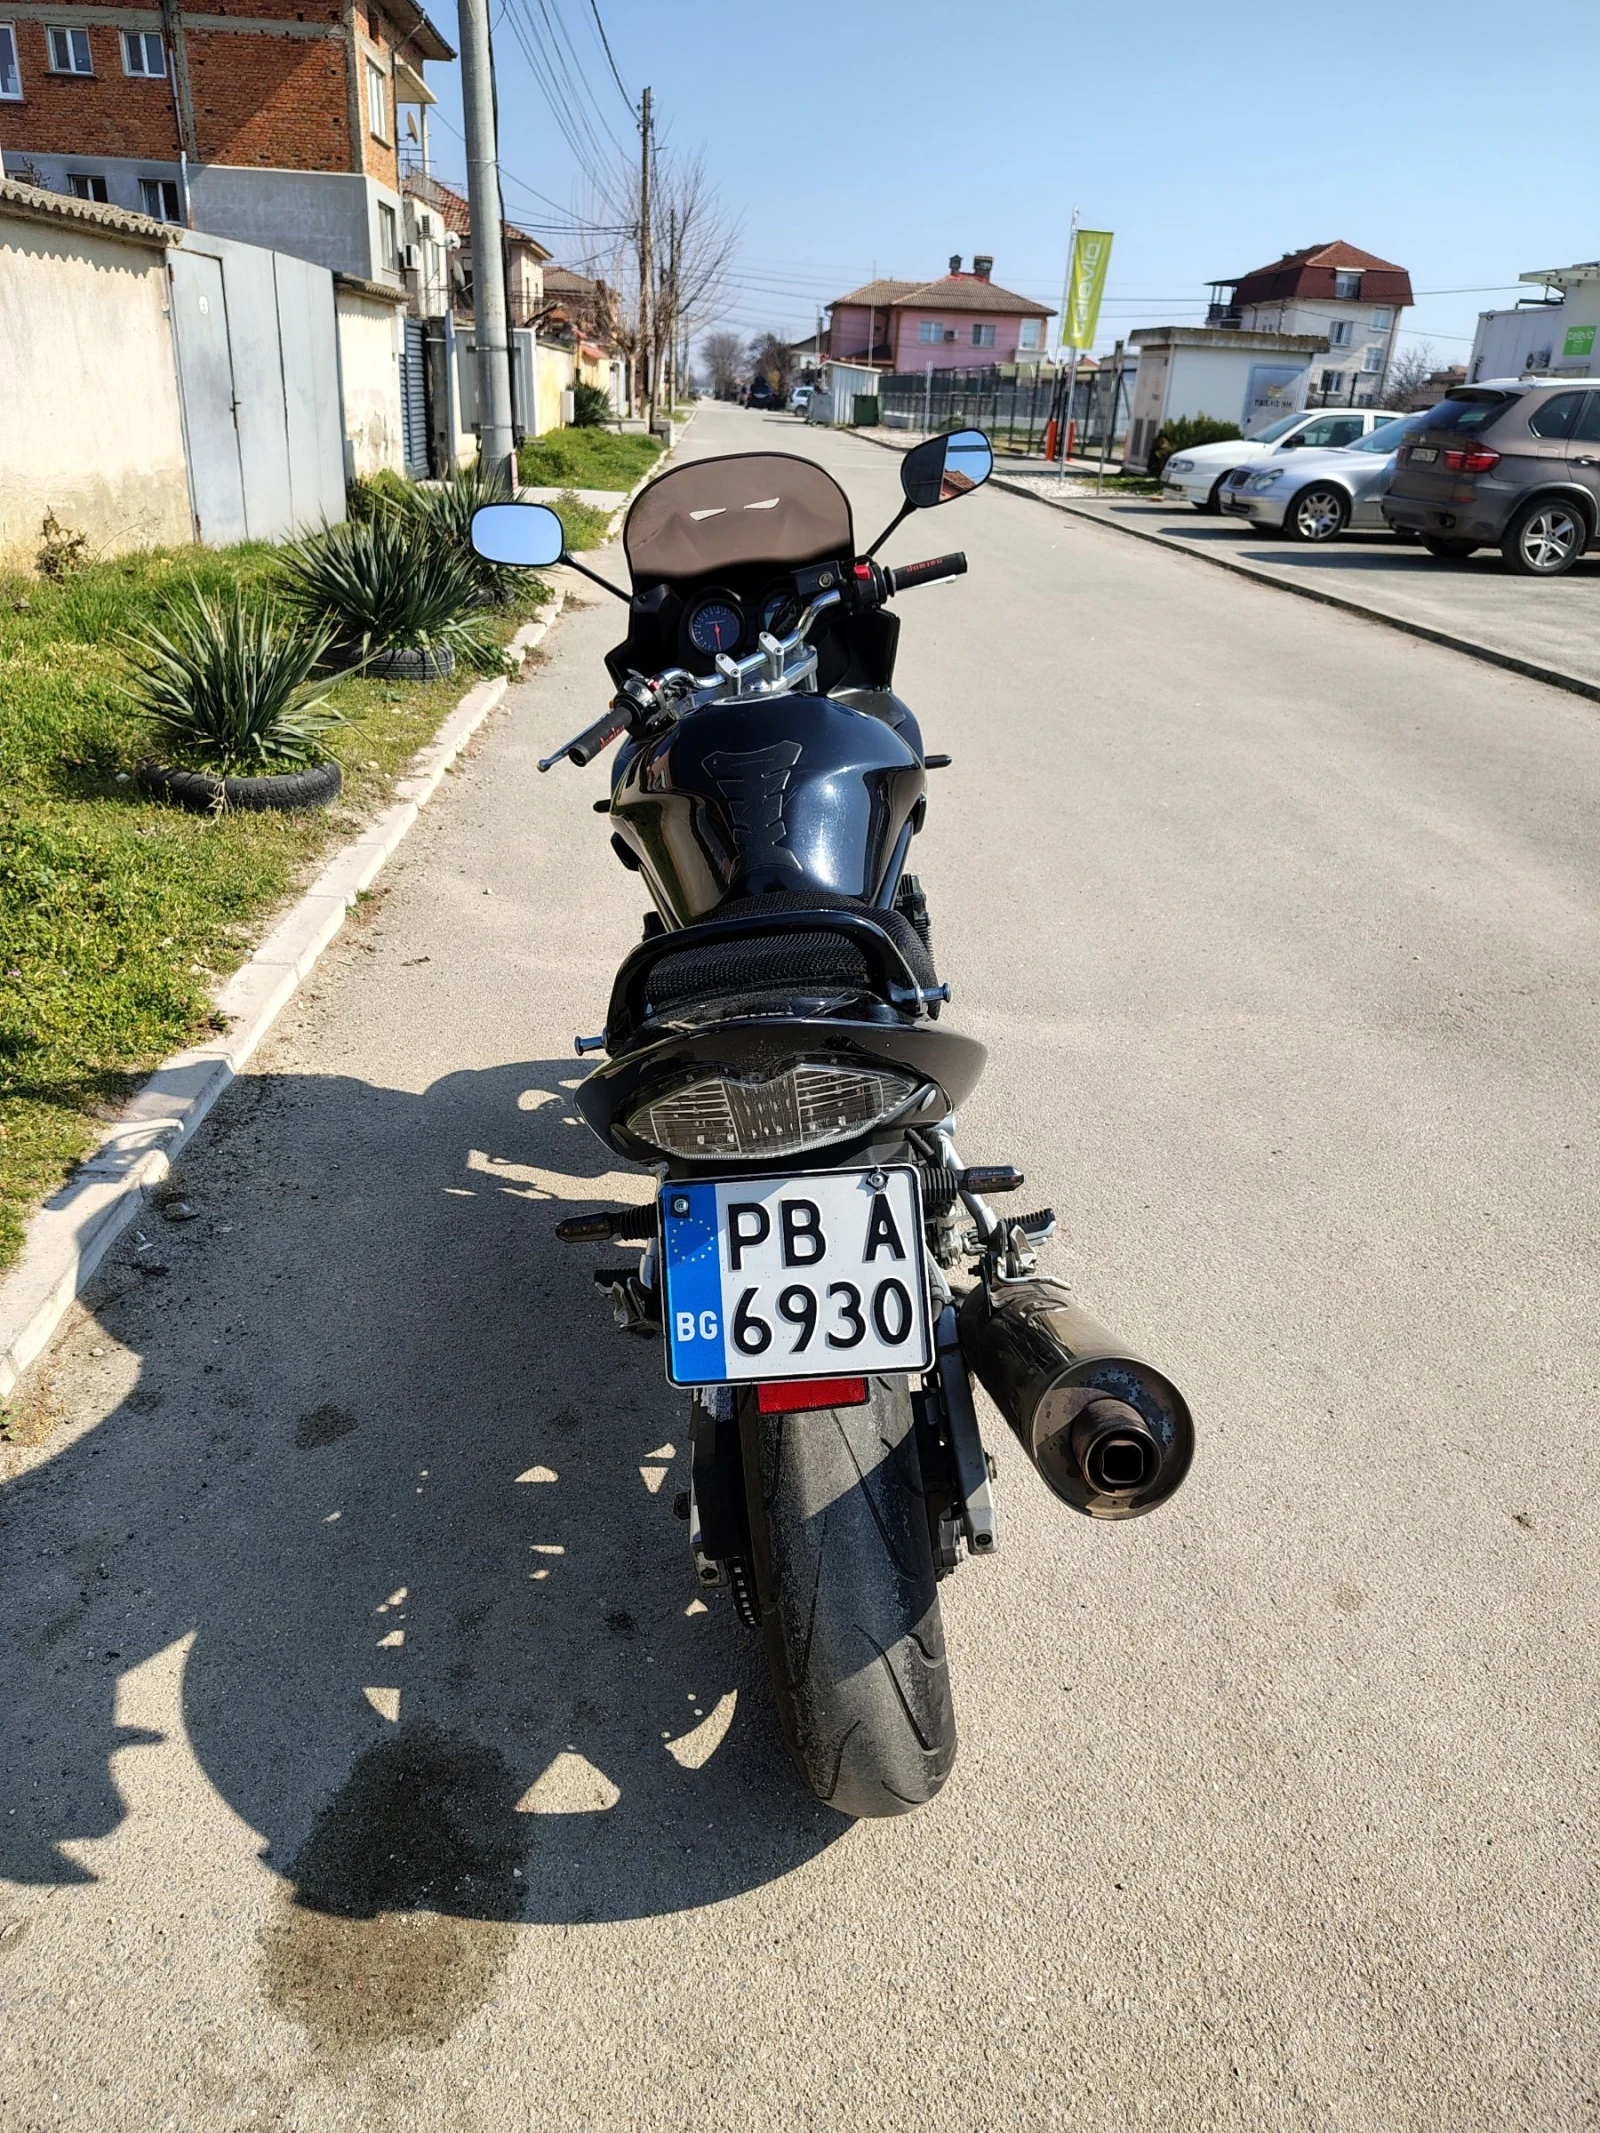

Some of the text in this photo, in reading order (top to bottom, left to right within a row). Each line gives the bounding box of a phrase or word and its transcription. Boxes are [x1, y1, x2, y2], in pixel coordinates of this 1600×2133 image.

[1072, 242, 1100, 338] televic
[727, 1193, 907, 1271] PB A
[676, 1310, 718, 1342] BG
[732, 1277, 914, 1356] 6930
